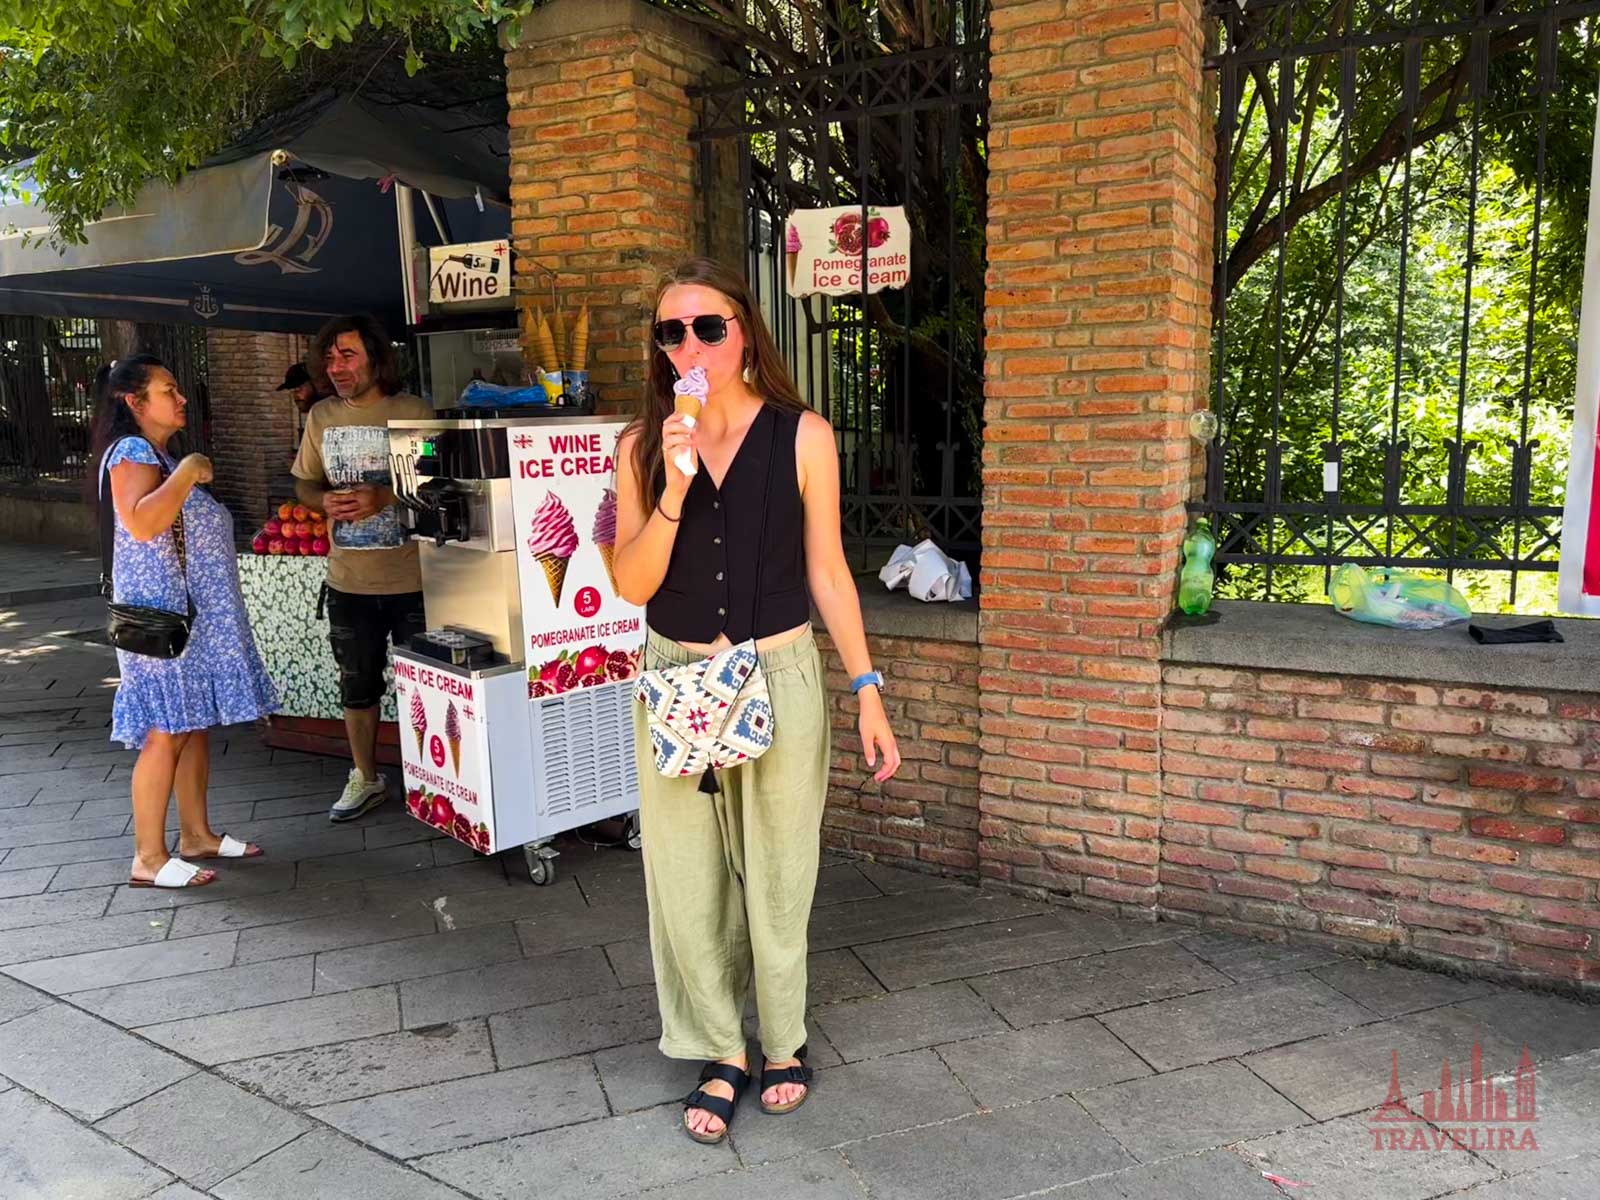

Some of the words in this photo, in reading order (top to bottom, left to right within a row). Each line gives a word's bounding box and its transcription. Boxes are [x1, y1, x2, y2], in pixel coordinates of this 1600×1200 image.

[813, 252, 907, 271] Pomeganate
[438, 272, 498, 299] Wine
[813, 273, 842, 288] Ice
[848, 269, 907, 286] ceam
[349, 430, 384, 441] ISLAND
[548, 434, 601, 454] WINE
[520, 459, 554, 479] ICE
[560, 455, 617, 476] CREA
[583, 591, 592, 605] 5
[531, 625, 596, 649] POMEGRANATE
[597, 622, 611, 638] ICE
[612, 617, 640, 635] CREAM
[393, 660, 417, 682] WINE
[418, 669, 434, 688] ICE
[436, 674, 474, 702] CREAM
[434, 739, 440, 754] 5
[404, 760, 444, 792] POMEGRANATE
[445, 777, 456, 795] ICE
[456, 782, 478, 806] CREAM
